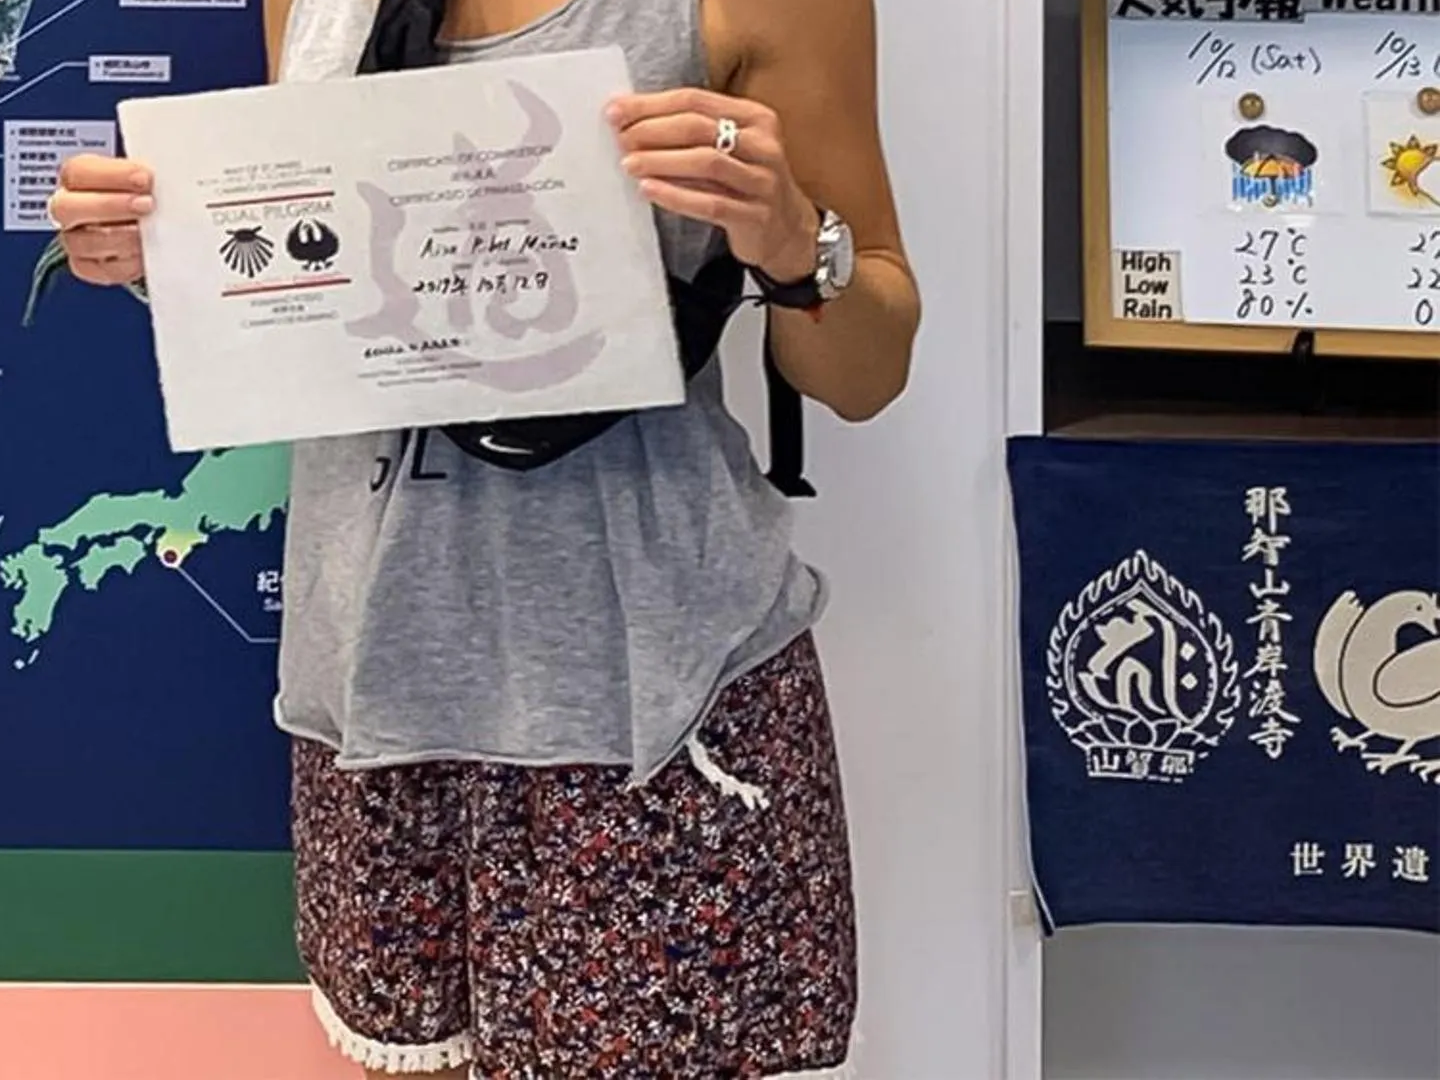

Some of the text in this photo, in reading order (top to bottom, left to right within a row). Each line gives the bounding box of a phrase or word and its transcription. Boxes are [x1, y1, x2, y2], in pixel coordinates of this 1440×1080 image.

[1251, 43, 1322, 76] (Sat)
[211, 207, 259, 225] DUAL
[1121, 250, 1172, 274] High
[1125, 274, 1169, 295] Low
[1123, 298, 1173, 319] Rain
[1289, 841, 1430, 882] 世界遺
